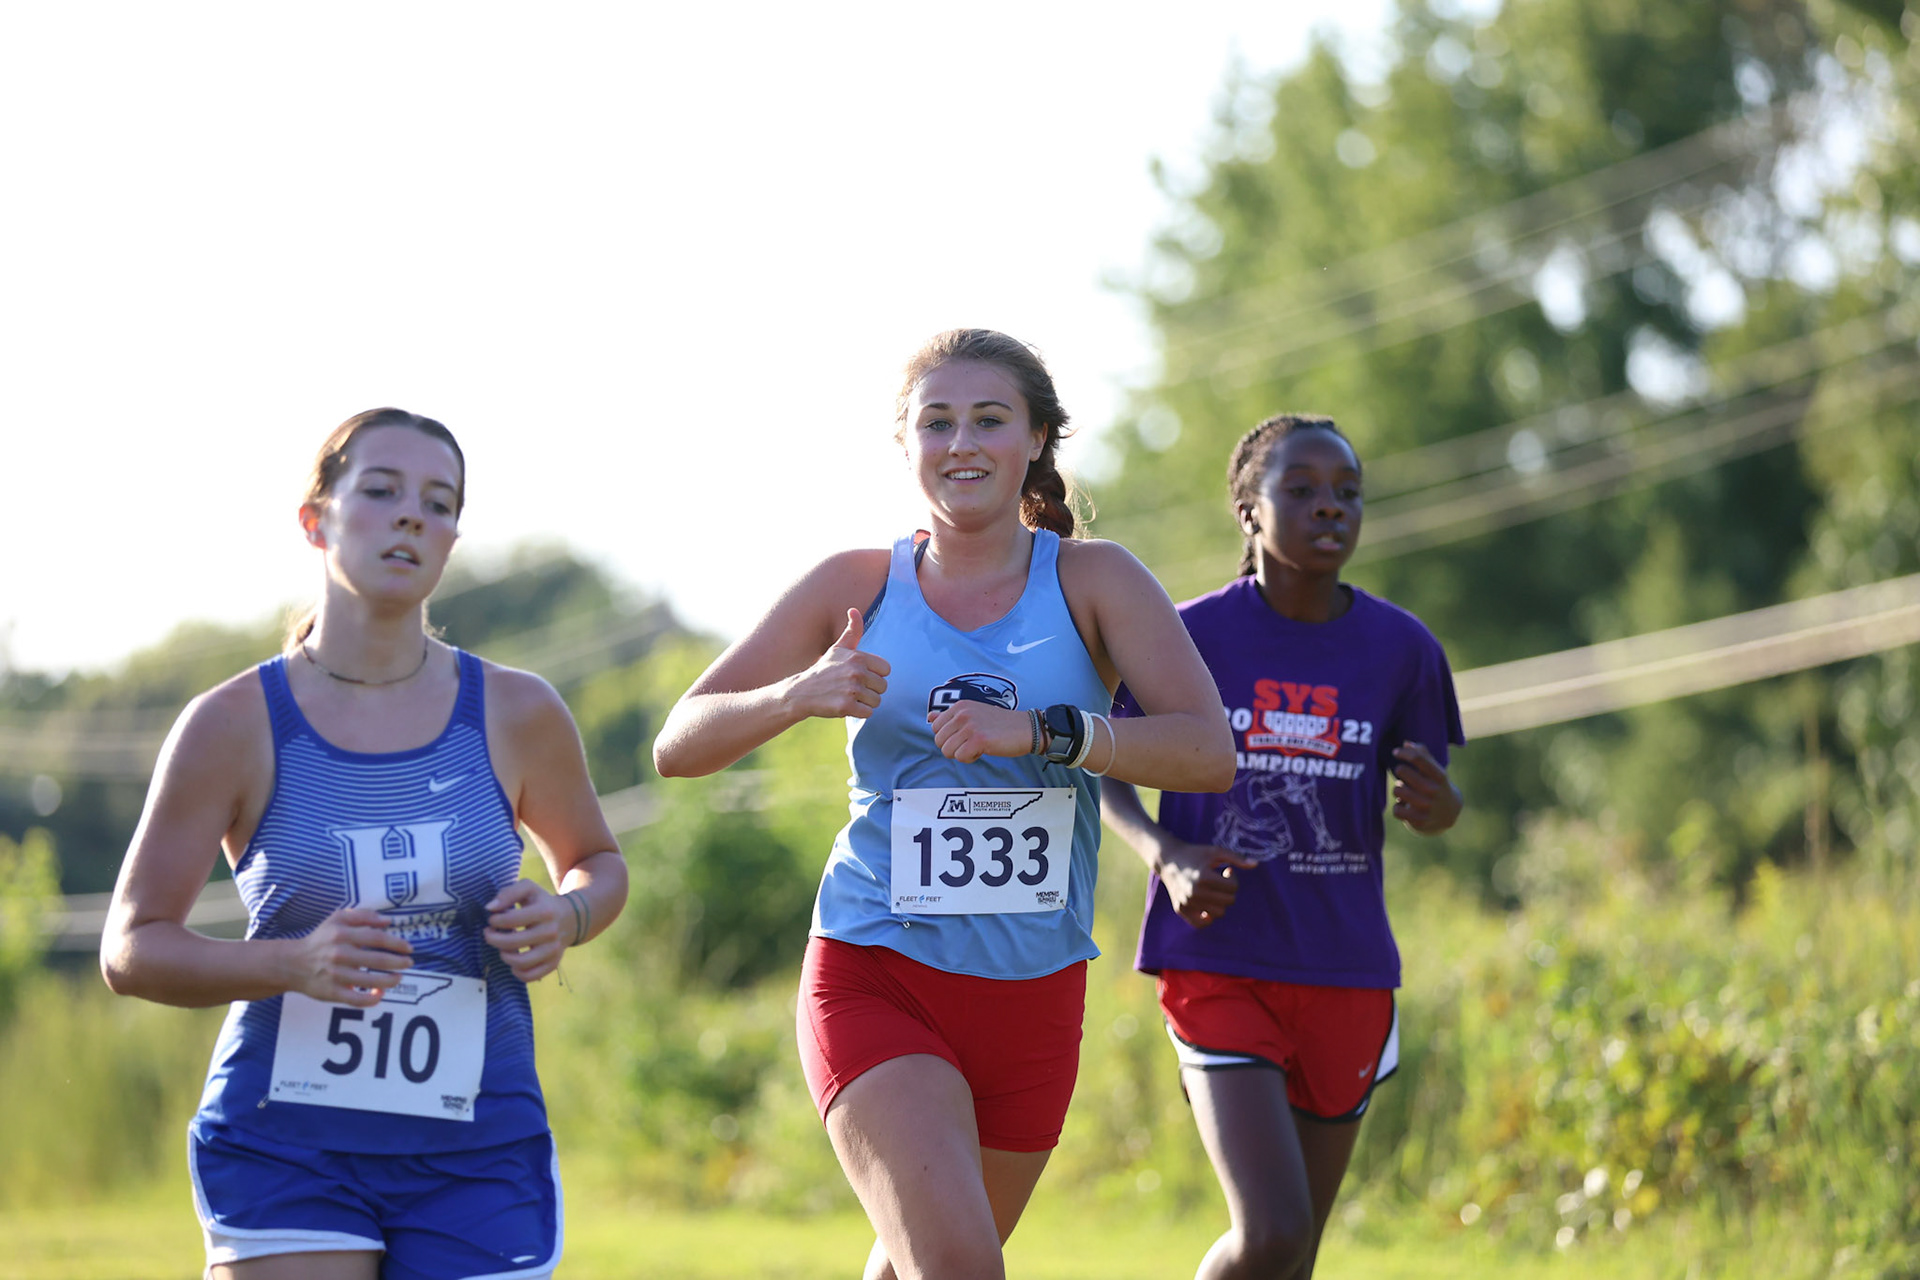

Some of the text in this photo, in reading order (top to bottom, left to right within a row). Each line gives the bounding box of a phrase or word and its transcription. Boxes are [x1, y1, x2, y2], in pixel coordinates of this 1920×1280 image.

[1253, 678, 1339, 717] SYS
[1341, 719, 1373, 744] 22
[327, 816, 460, 914] H
[913, 826, 1050, 887] 1333
[321, 1007, 440, 1084] 510
